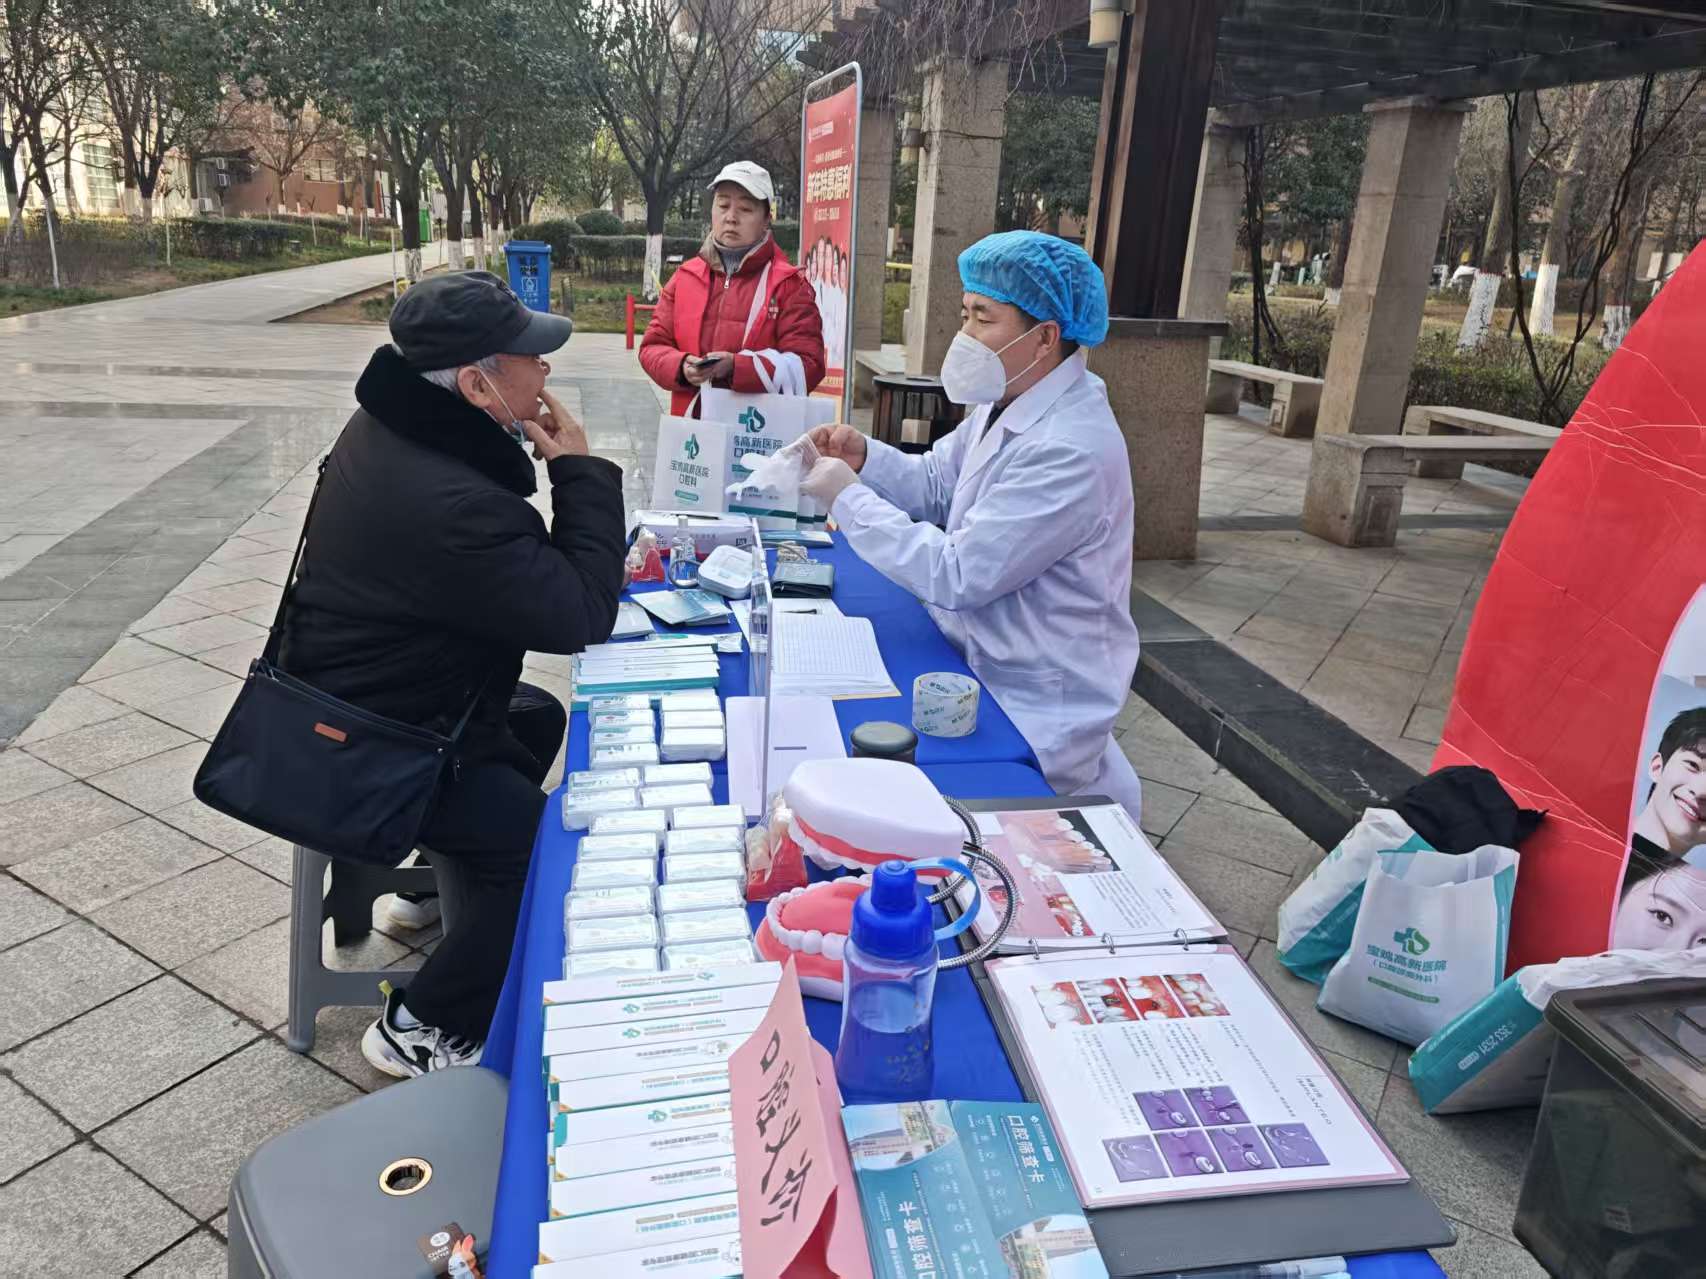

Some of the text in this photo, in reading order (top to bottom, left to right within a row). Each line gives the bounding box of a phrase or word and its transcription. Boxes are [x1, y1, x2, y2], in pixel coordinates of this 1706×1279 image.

[1366, 945, 1447, 972] 宝鸡高新医院
[757, 1029, 812, 1226] 口腔义诊
[1007, 1115, 1045, 1183] 口腔筛查卡
